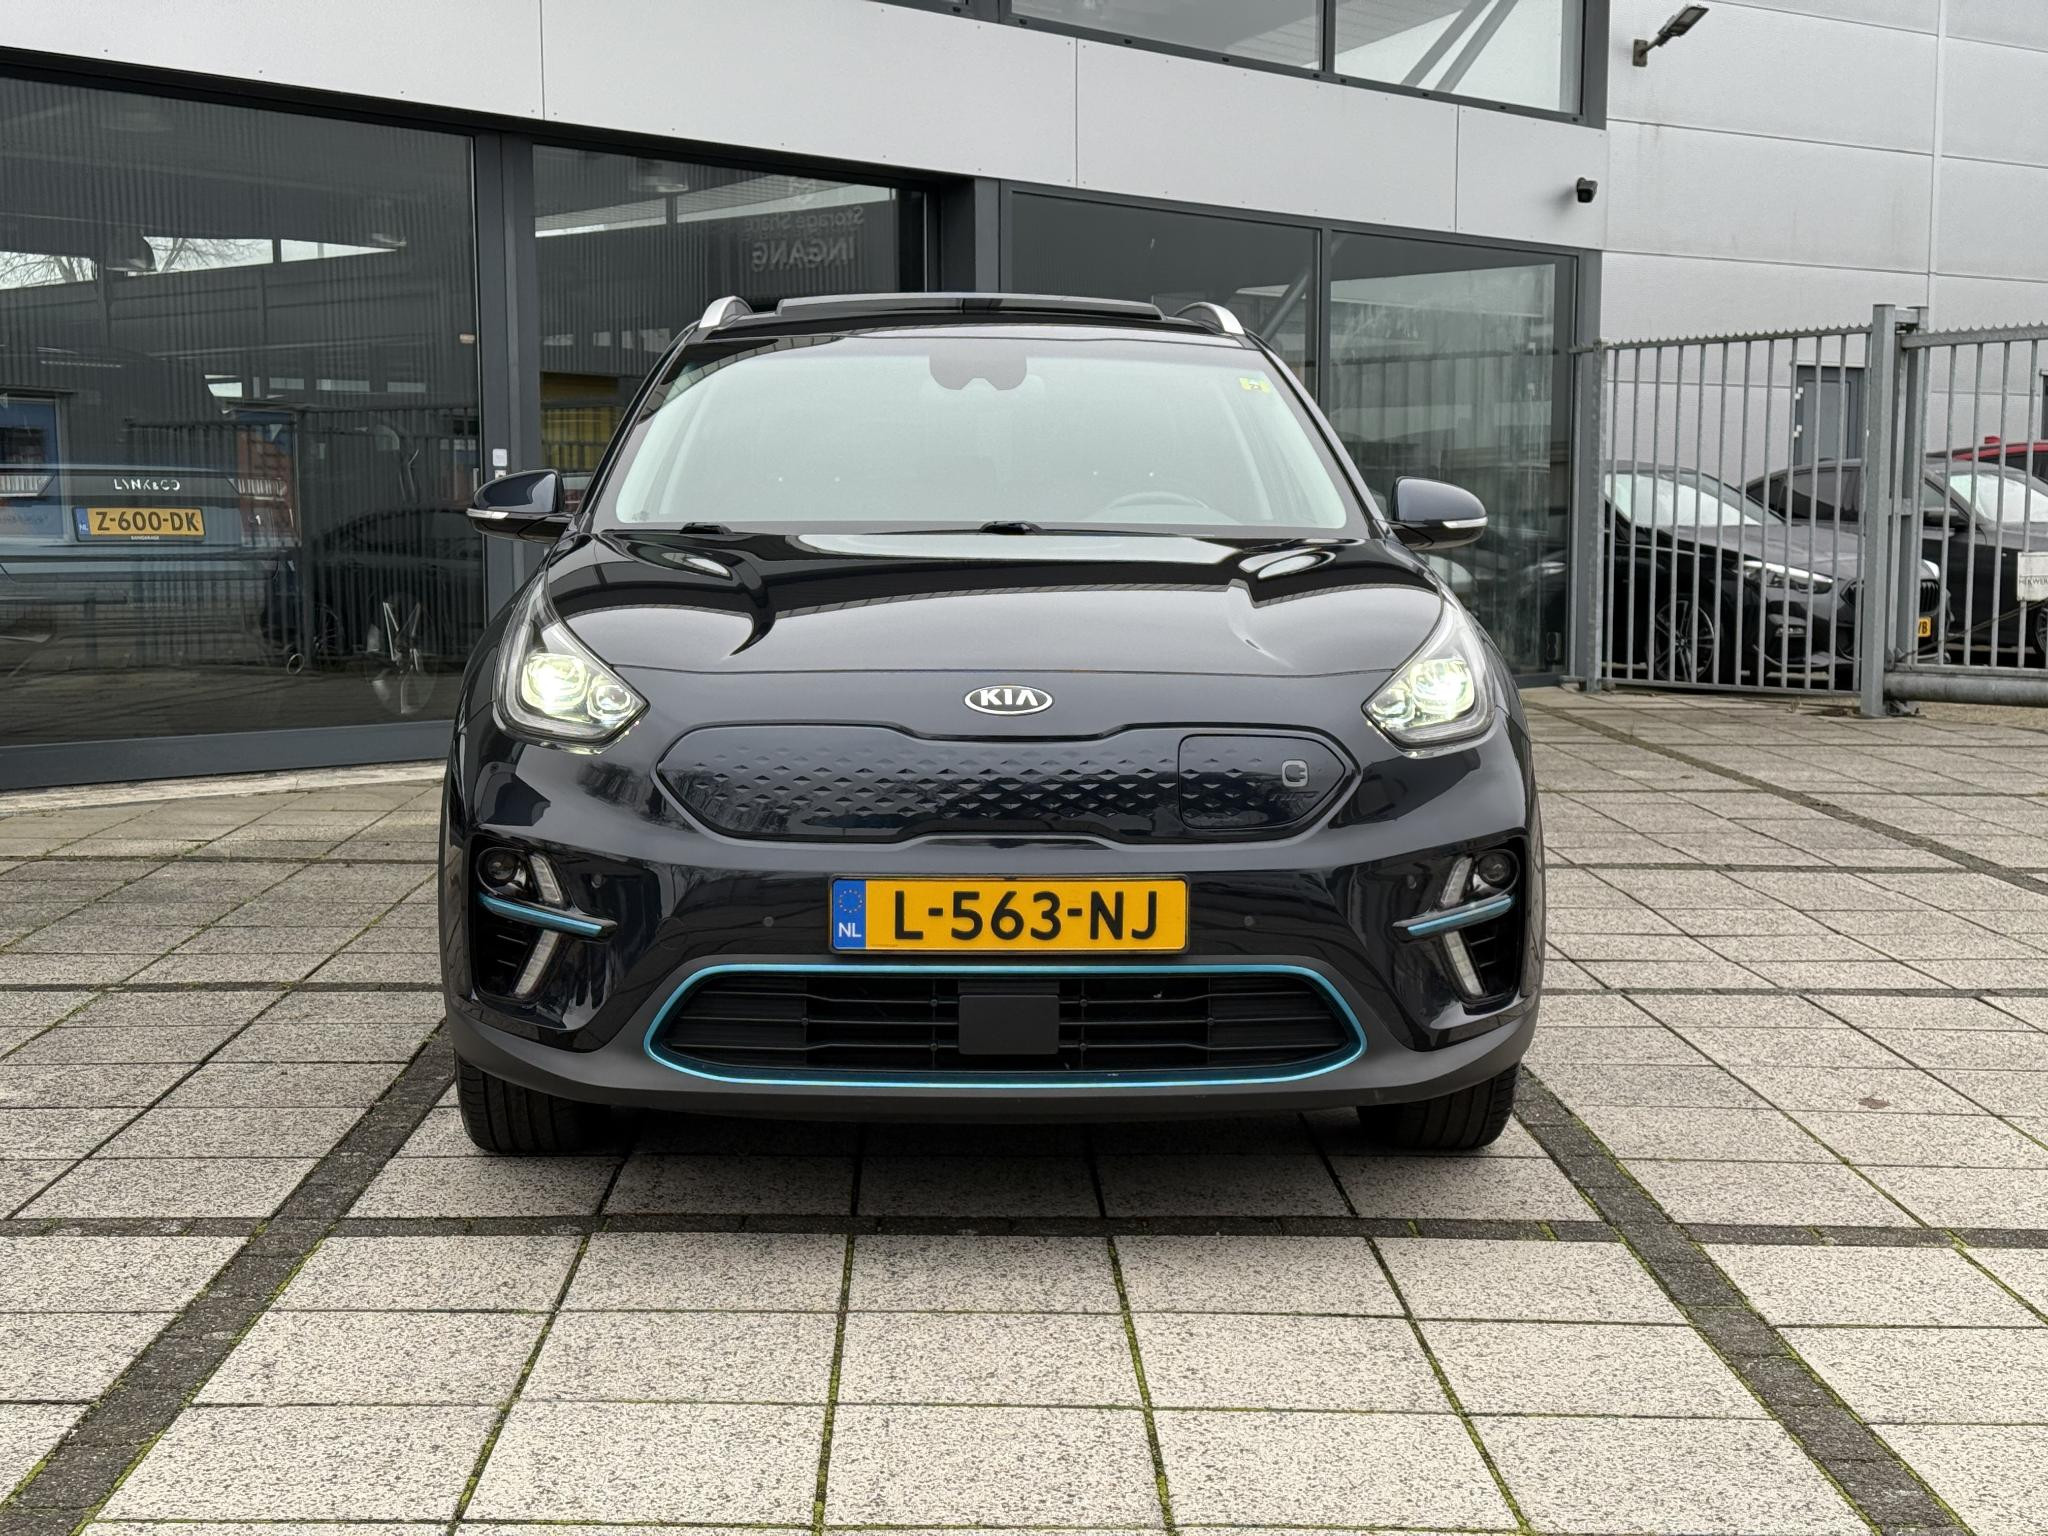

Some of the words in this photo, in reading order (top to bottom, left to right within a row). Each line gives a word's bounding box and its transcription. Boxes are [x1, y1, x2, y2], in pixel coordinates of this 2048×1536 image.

[95, 511, 199, 532] Z-600-DK
[980, 688, 1039, 706] KIA
[894, 890, 1158, 941] L-563-NJ
[838, 922, 862, 938] NL
